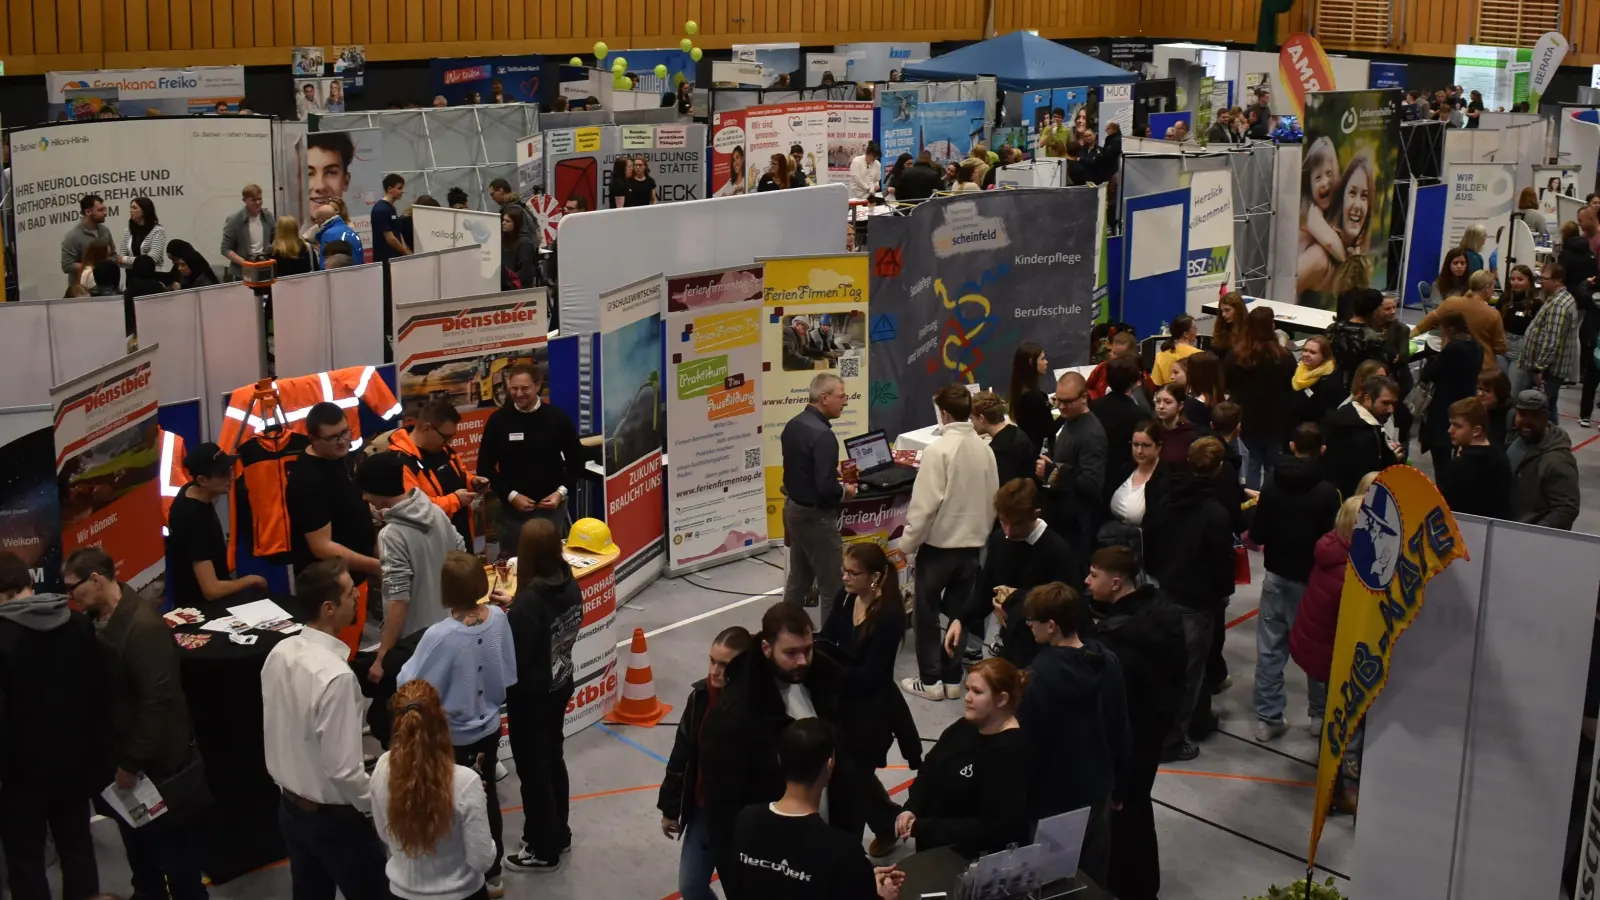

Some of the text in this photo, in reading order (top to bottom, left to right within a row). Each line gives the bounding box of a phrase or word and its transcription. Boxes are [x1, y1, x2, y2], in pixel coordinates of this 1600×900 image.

[1535, 47, 1554, 85] BERATA
[158, 77, 197, 89] Freiko
[1106, 86, 1128, 97] MUCK
[836, 131, 846, 139] DIR
[847, 131, 857, 139] DIE
[659, 161, 698, 173] STÄTTE
[15, 169, 170, 199] IHRE NEUROLOGISCHE UND
[1456, 173, 1474, 182] WIR
[104, 185, 184, 201] REHAKLINIK
[1456, 183, 1488, 192] BILDEN
[1194, 184, 1223, 207] Herzlich
[1455, 192, 1475, 201] AUS.
[28, 216, 46, 231] BAD
[952, 228, 997, 246] scheinfeld
[1014, 252, 1082, 266] Kinderpflege
[443, 306, 537, 332] Dienstbier
[1014, 304, 1082, 319] Berufsschule
[679, 365, 728, 389] Praktikum
[84, 368, 152, 414] Dienstbier
[676, 470, 763, 498] www.ferienfirmentag.de
[609, 483, 645, 515] BRAUCHT
[76, 528, 89, 544] Wir
[90, 512, 118, 537] können:
[3, 535, 40, 548] Welkom
